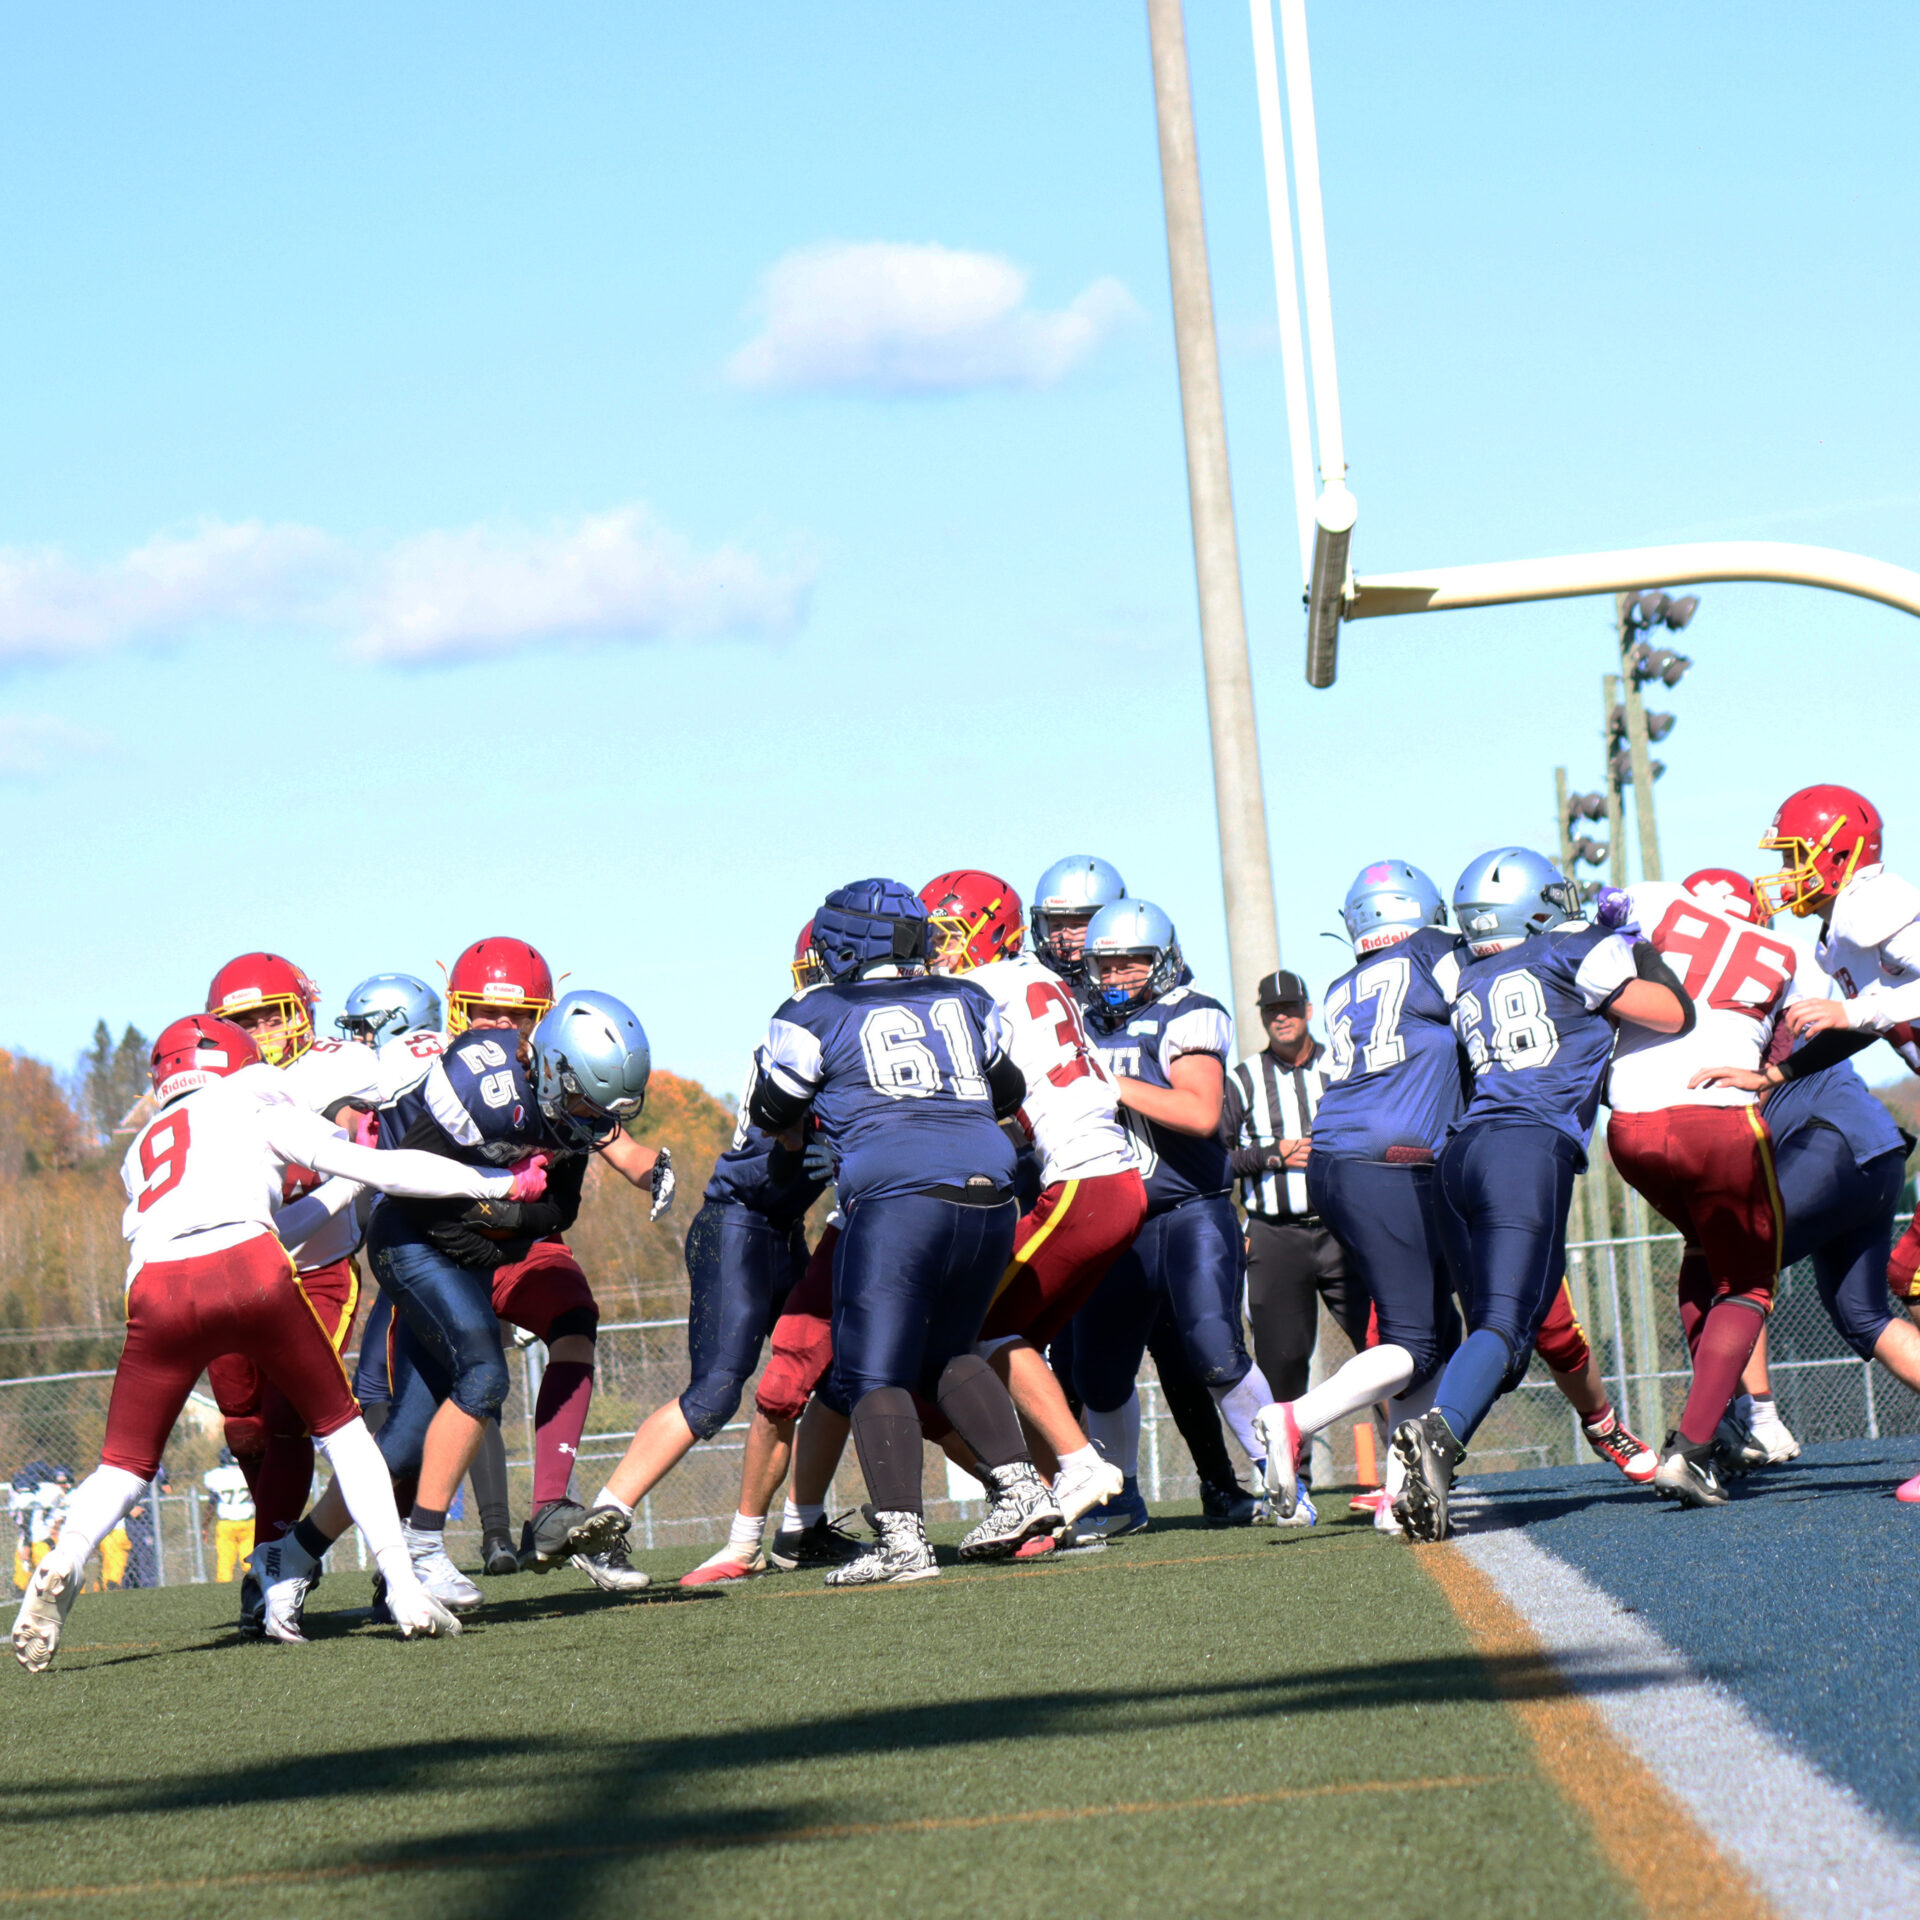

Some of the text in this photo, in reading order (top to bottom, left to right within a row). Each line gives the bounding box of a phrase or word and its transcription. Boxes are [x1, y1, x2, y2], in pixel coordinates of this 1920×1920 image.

[1362, 931, 1409, 951] Riddell
[1652, 899, 1796, 1020] 96
[405, 1034, 444, 1058] 43
[859, 997, 989, 1101] 61
[1026, 980, 1108, 1088] 3
[161, 1073, 207, 1098] Riddell
[456, 1040, 521, 1109] 25
[138, 1107, 191, 1213] 9
[266, 1546, 282, 1577] NIKE
